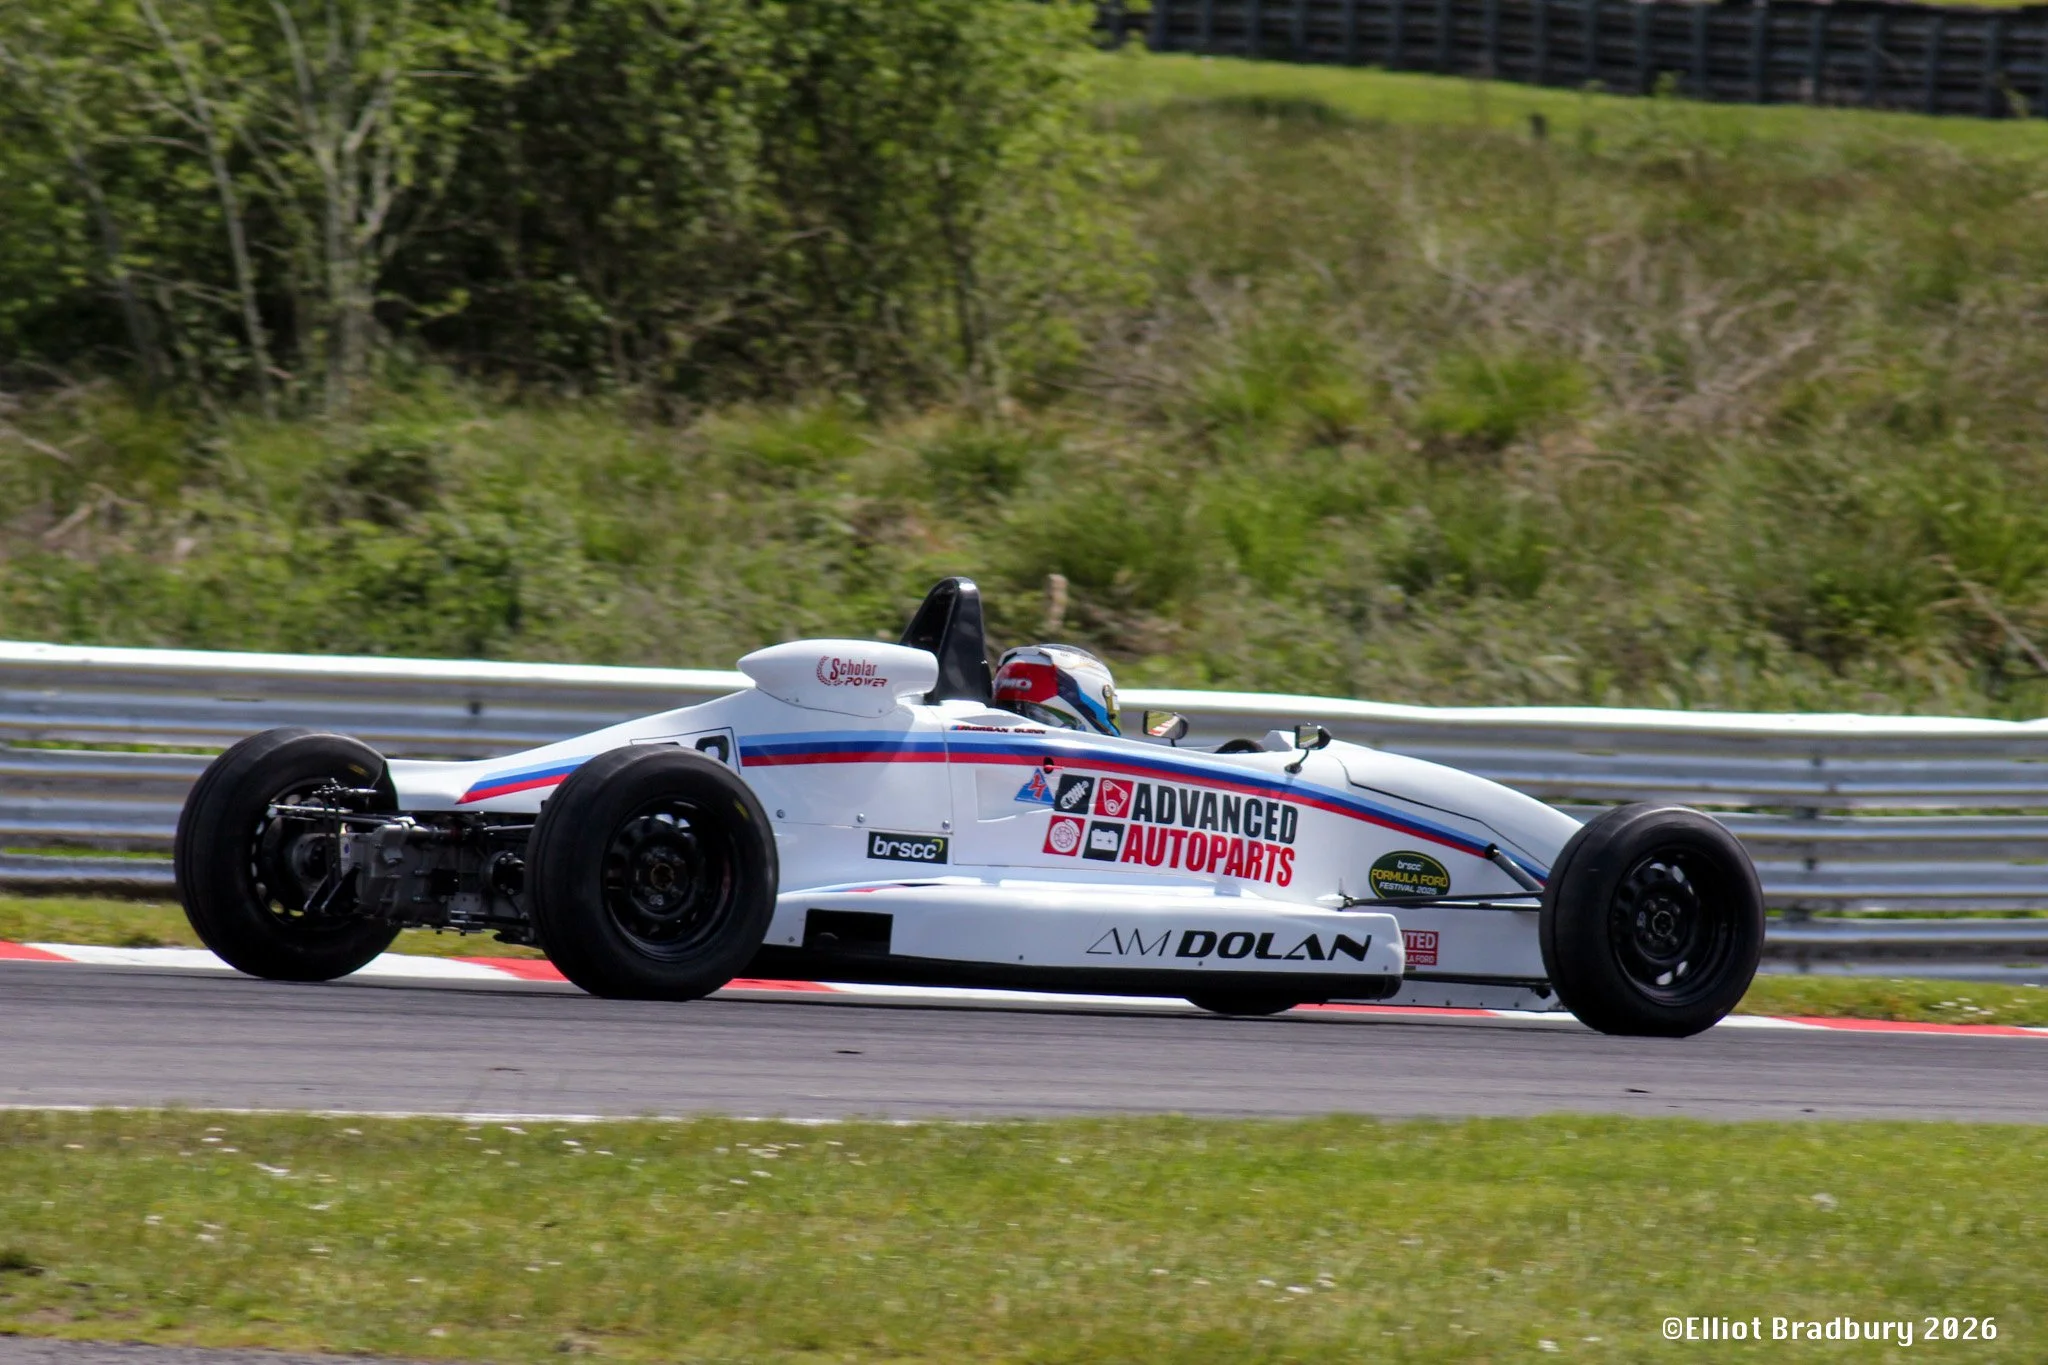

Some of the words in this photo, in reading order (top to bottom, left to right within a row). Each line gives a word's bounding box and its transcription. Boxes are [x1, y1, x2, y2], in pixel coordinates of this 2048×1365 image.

[830, 658, 877, 680] Scholar
[844, 677, 888, 687] POWER
[1131, 783, 1299, 845] ADVANCED
[873, 835, 937, 859] brscc
[1120, 824, 1296, 887] AUTOPARTS
[1396, 860, 1422, 871] brscc
[1371, 869, 1418, 884] FORMULA
[1420, 875, 1448, 887] FORD
[1378, 881, 1416, 893] FESTIVAL
[1416, 885, 1438, 895] 2025
[1086, 927, 1172, 957] AM
[1175, 930, 1372, 962] DOLAN
[1415, 955, 1435, 964] FORD
